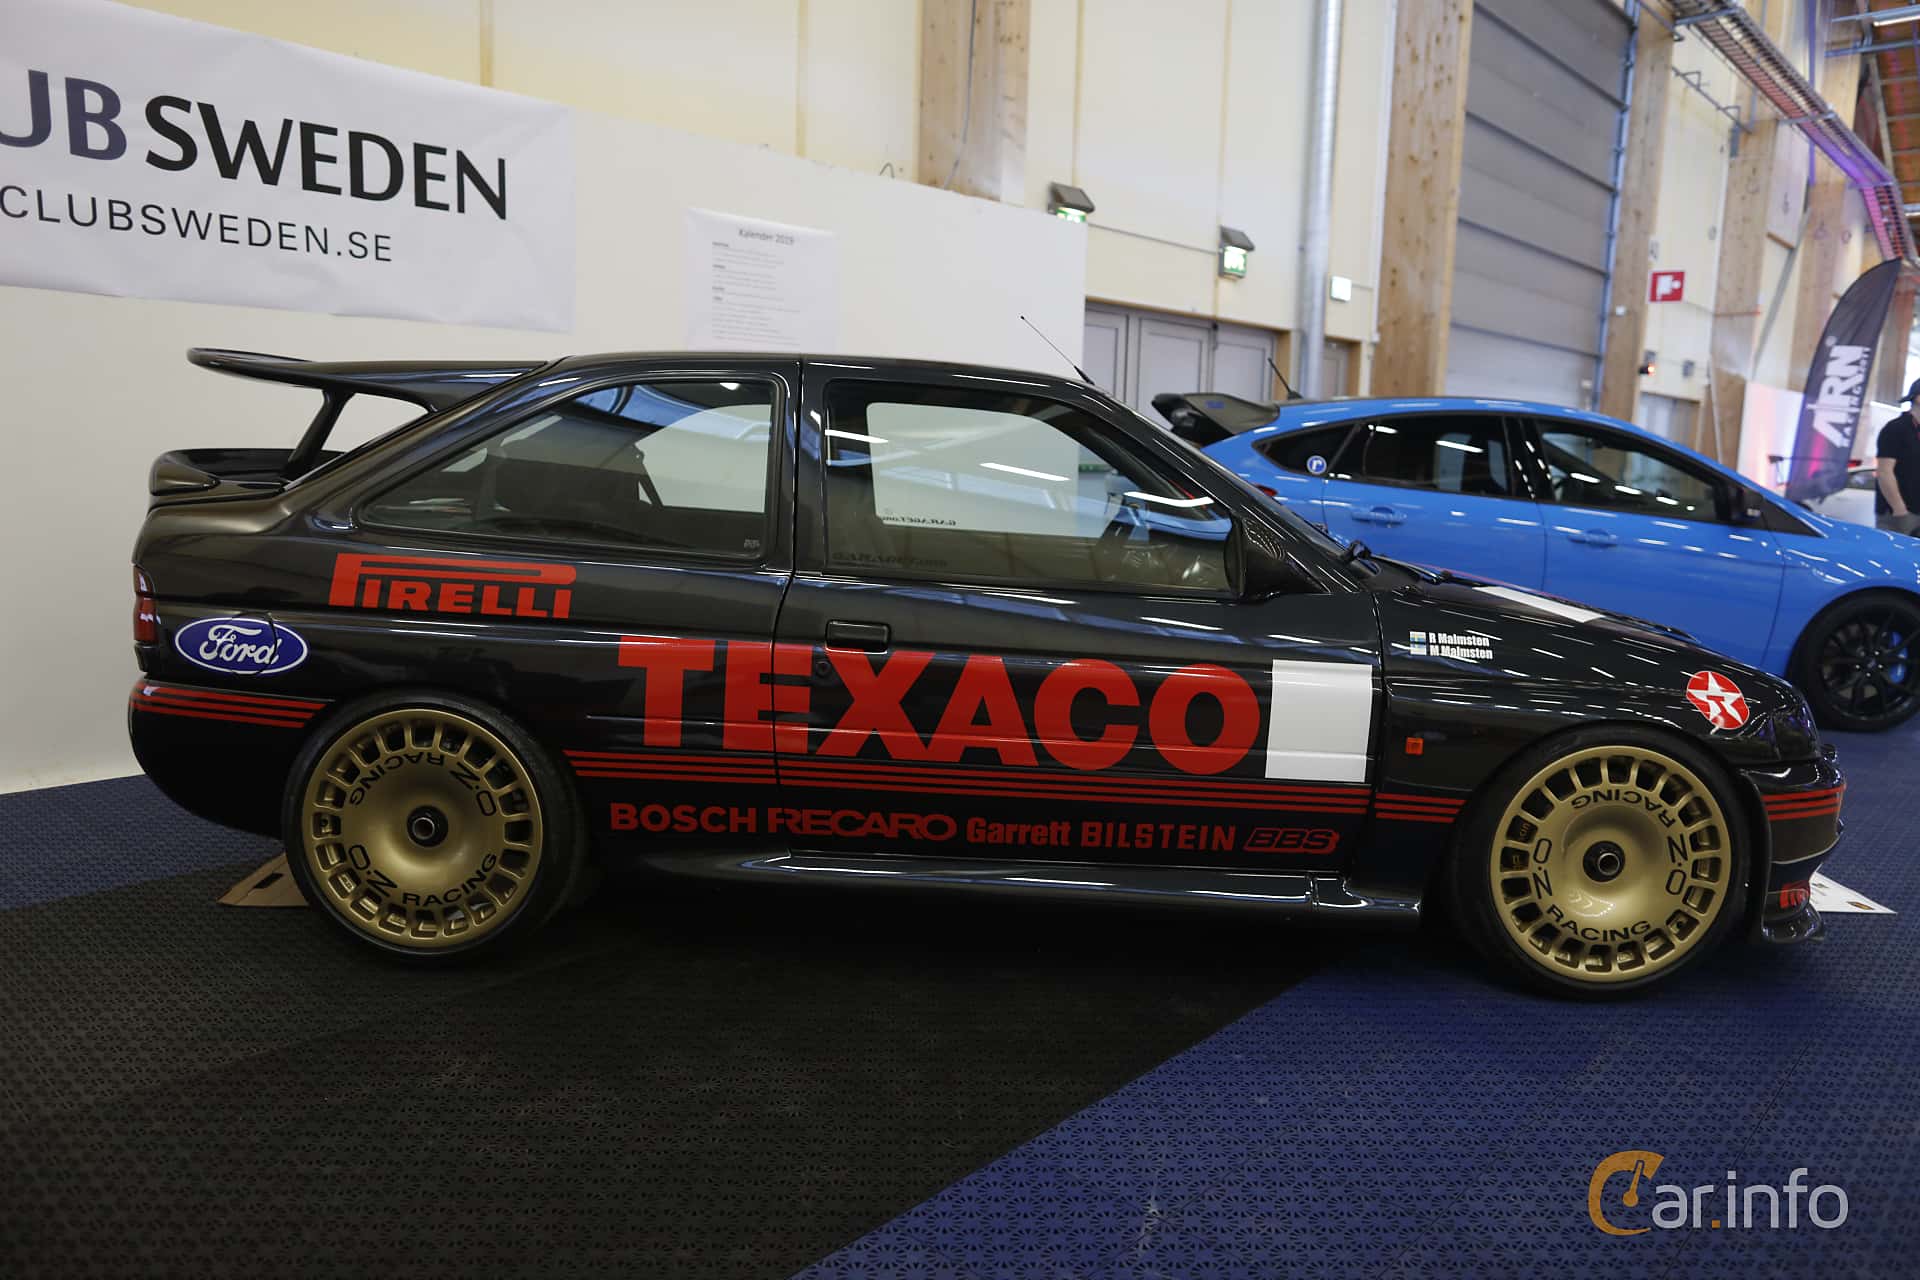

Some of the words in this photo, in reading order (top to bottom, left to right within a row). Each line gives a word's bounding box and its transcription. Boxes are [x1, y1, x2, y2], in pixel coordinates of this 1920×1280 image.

[145, 95, 508, 220] SWEDEN
[0, 185, 392, 261] CLUBSWEDEN.SE
[329, 552, 576, 619] PIRELLI
[199, 624, 281, 664] Ford
[1429, 644, 1440, 656] M
[1440, 645, 1494, 660] Malmsten
[1437, 632, 1490, 647] Malmsten
[617, 635, 1261, 775] TEXACO
[350, 752, 445, 806] RACING
[609, 802, 757, 833] BOSCH
[767, 807, 957, 841] RECARO
[1571, 789, 1676, 828] RACING
[966, 817, 1071, 848] Garrett
[1081, 821, 1236, 851] BILSTEIN
[1243, 827, 1340, 855] BBS
[402, 853, 497, 906] RACING
[1547, 904, 1651, 942] RACING
